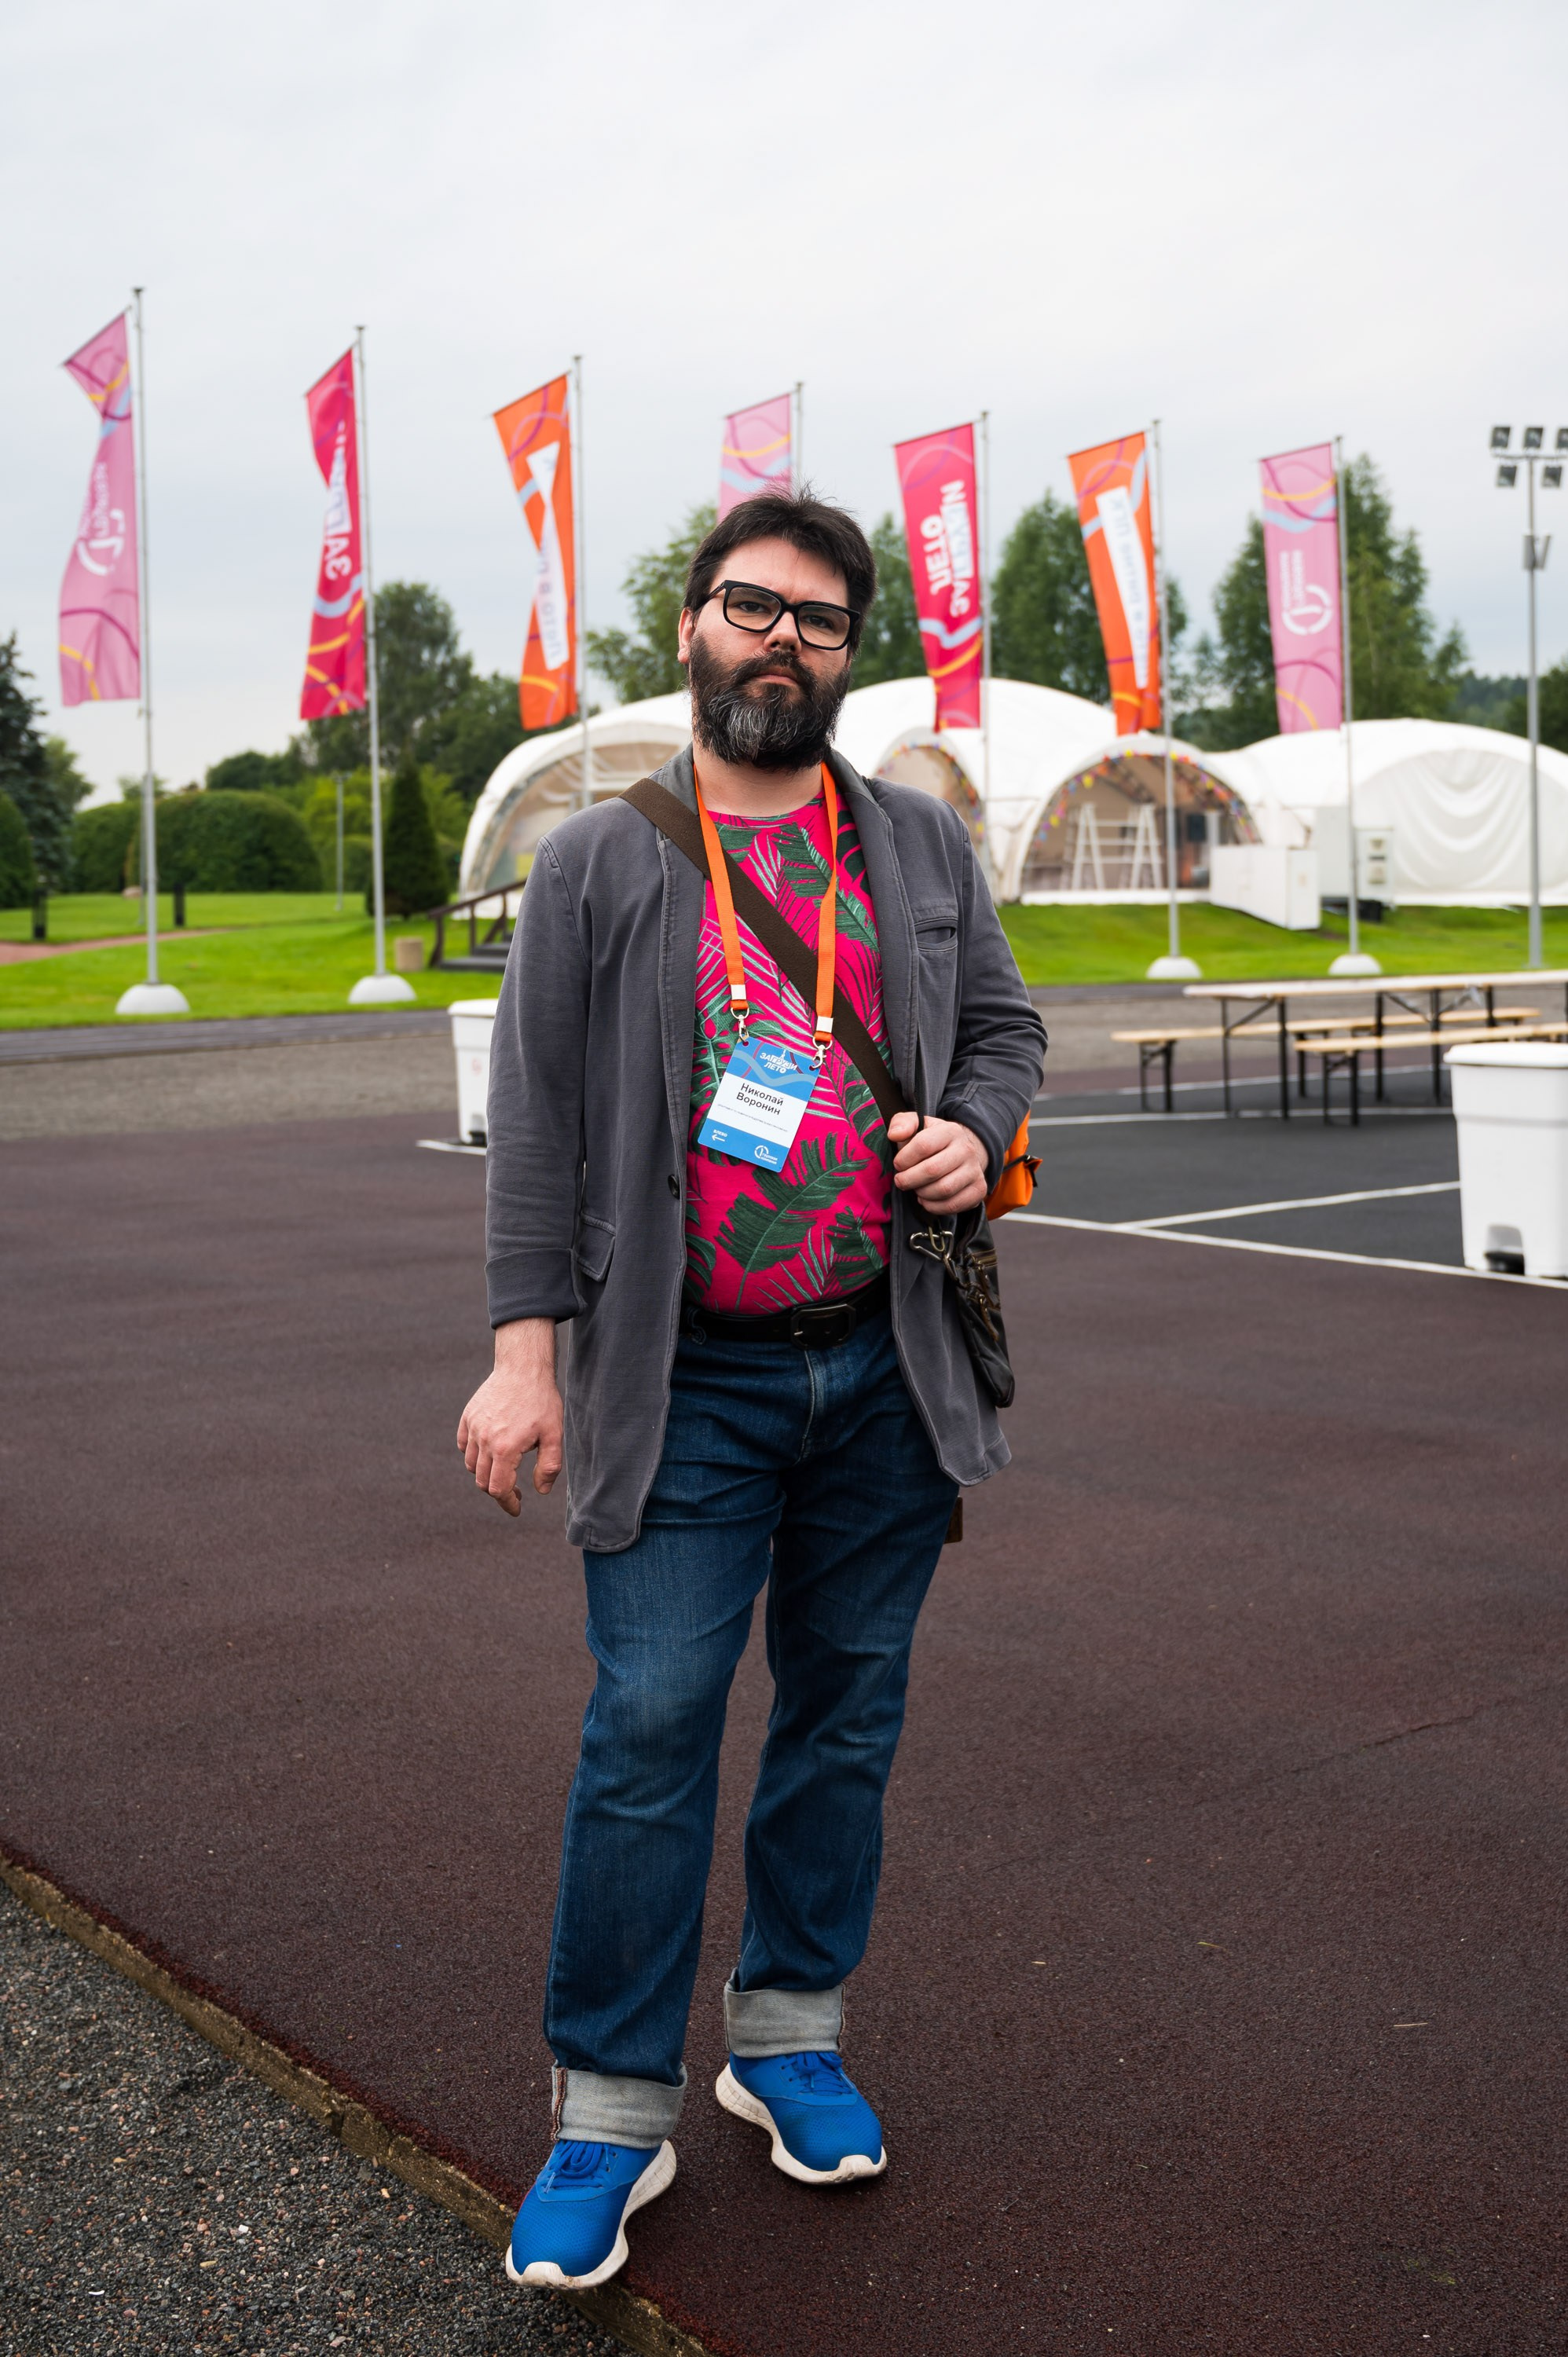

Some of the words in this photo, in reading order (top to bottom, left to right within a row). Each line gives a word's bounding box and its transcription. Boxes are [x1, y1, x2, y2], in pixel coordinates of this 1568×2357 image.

[760, 1052, 797, 1071] ЗАГРУЗИ
[764, 1061, 786, 1074] ЛЕТО
[736, 1092, 781, 1116] Воронин
[741, 1083, 784, 1106] Николай
